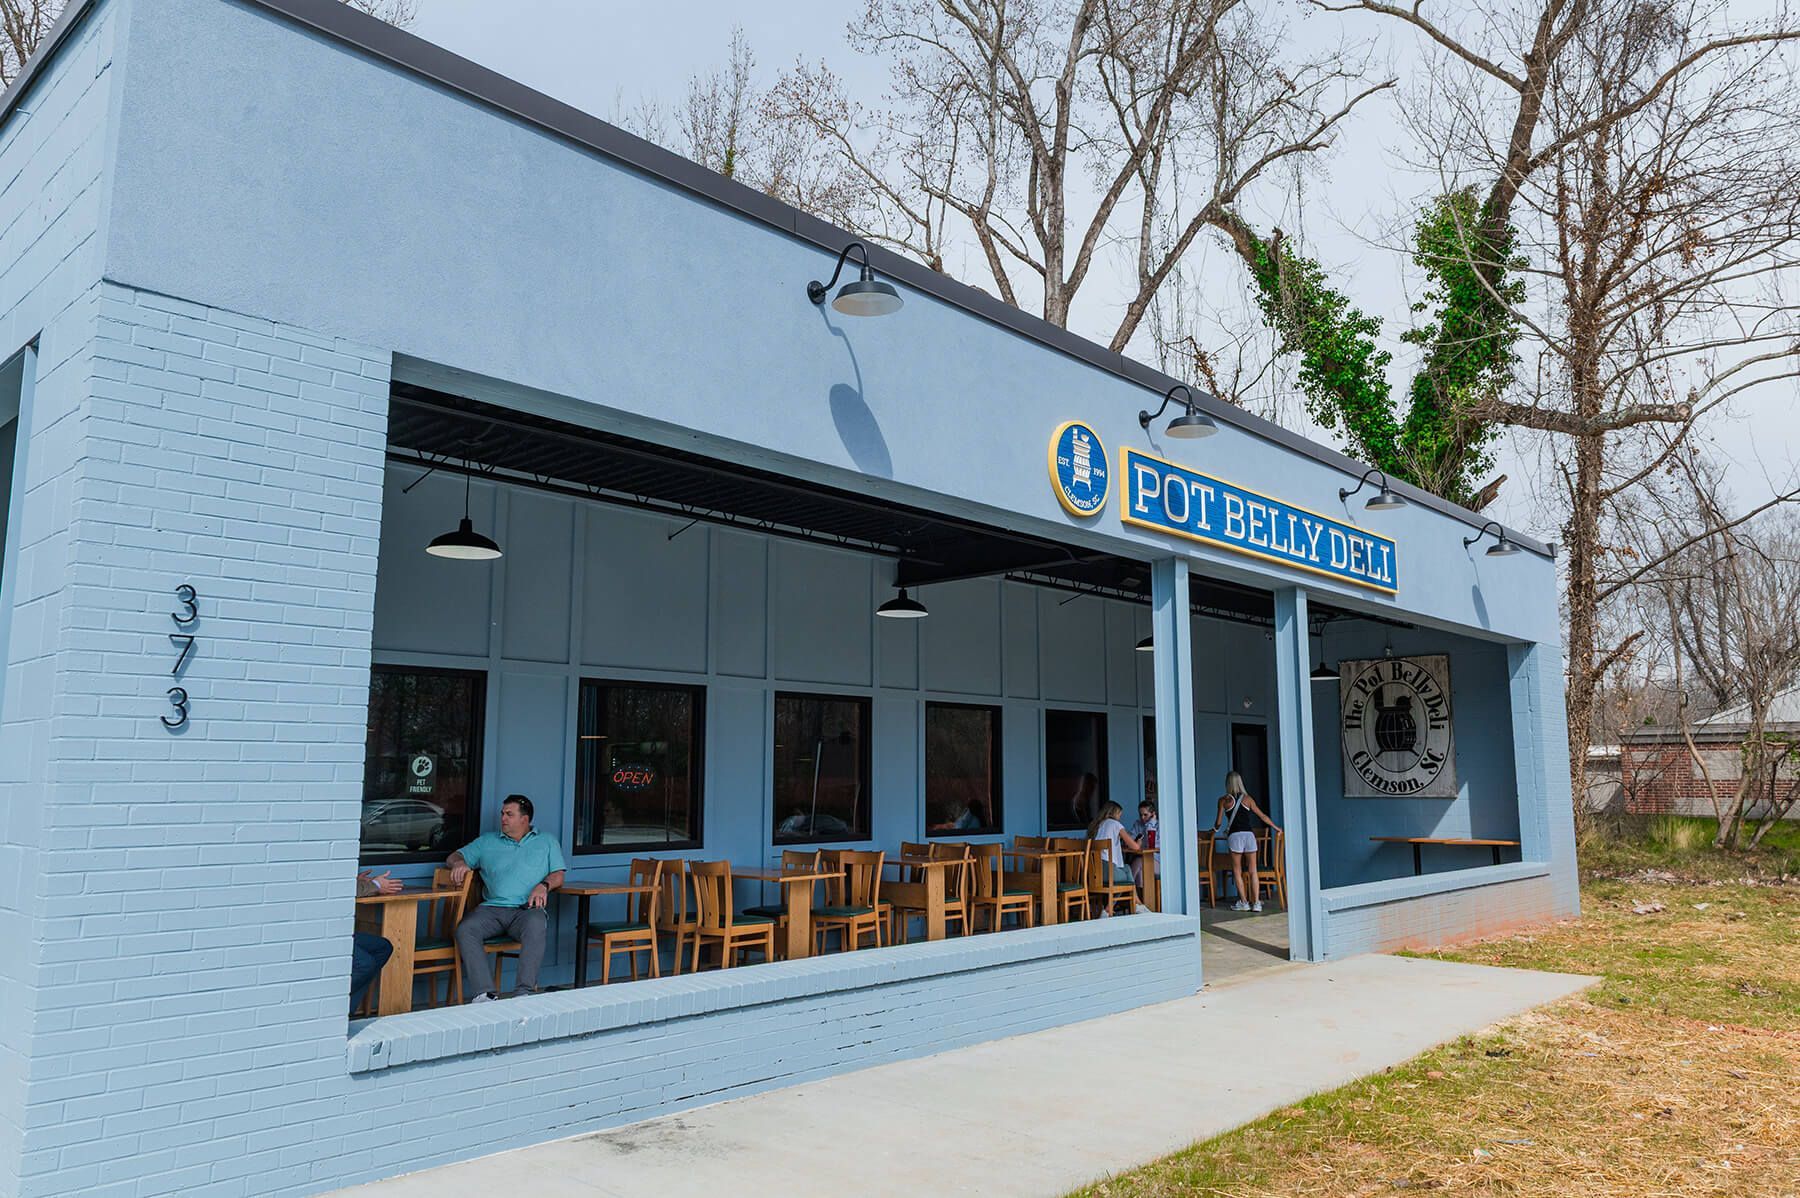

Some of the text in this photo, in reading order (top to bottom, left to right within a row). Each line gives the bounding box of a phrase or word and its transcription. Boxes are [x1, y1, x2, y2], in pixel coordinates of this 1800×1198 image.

[1058, 456, 1070, 467] EST.
[1093, 494, 1100, 505] SC
[1134, 462, 1392, 583] POT BELLY DELI
[160, 584, 198, 726] 373
[1344, 662, 1448, 733] The Pot Belly Deli
[613, 771, 654, 784] OPEN
[1352, 748, 1445, 793] Clemson, SC
[409, 785, 432, 793] FRIENDLY
